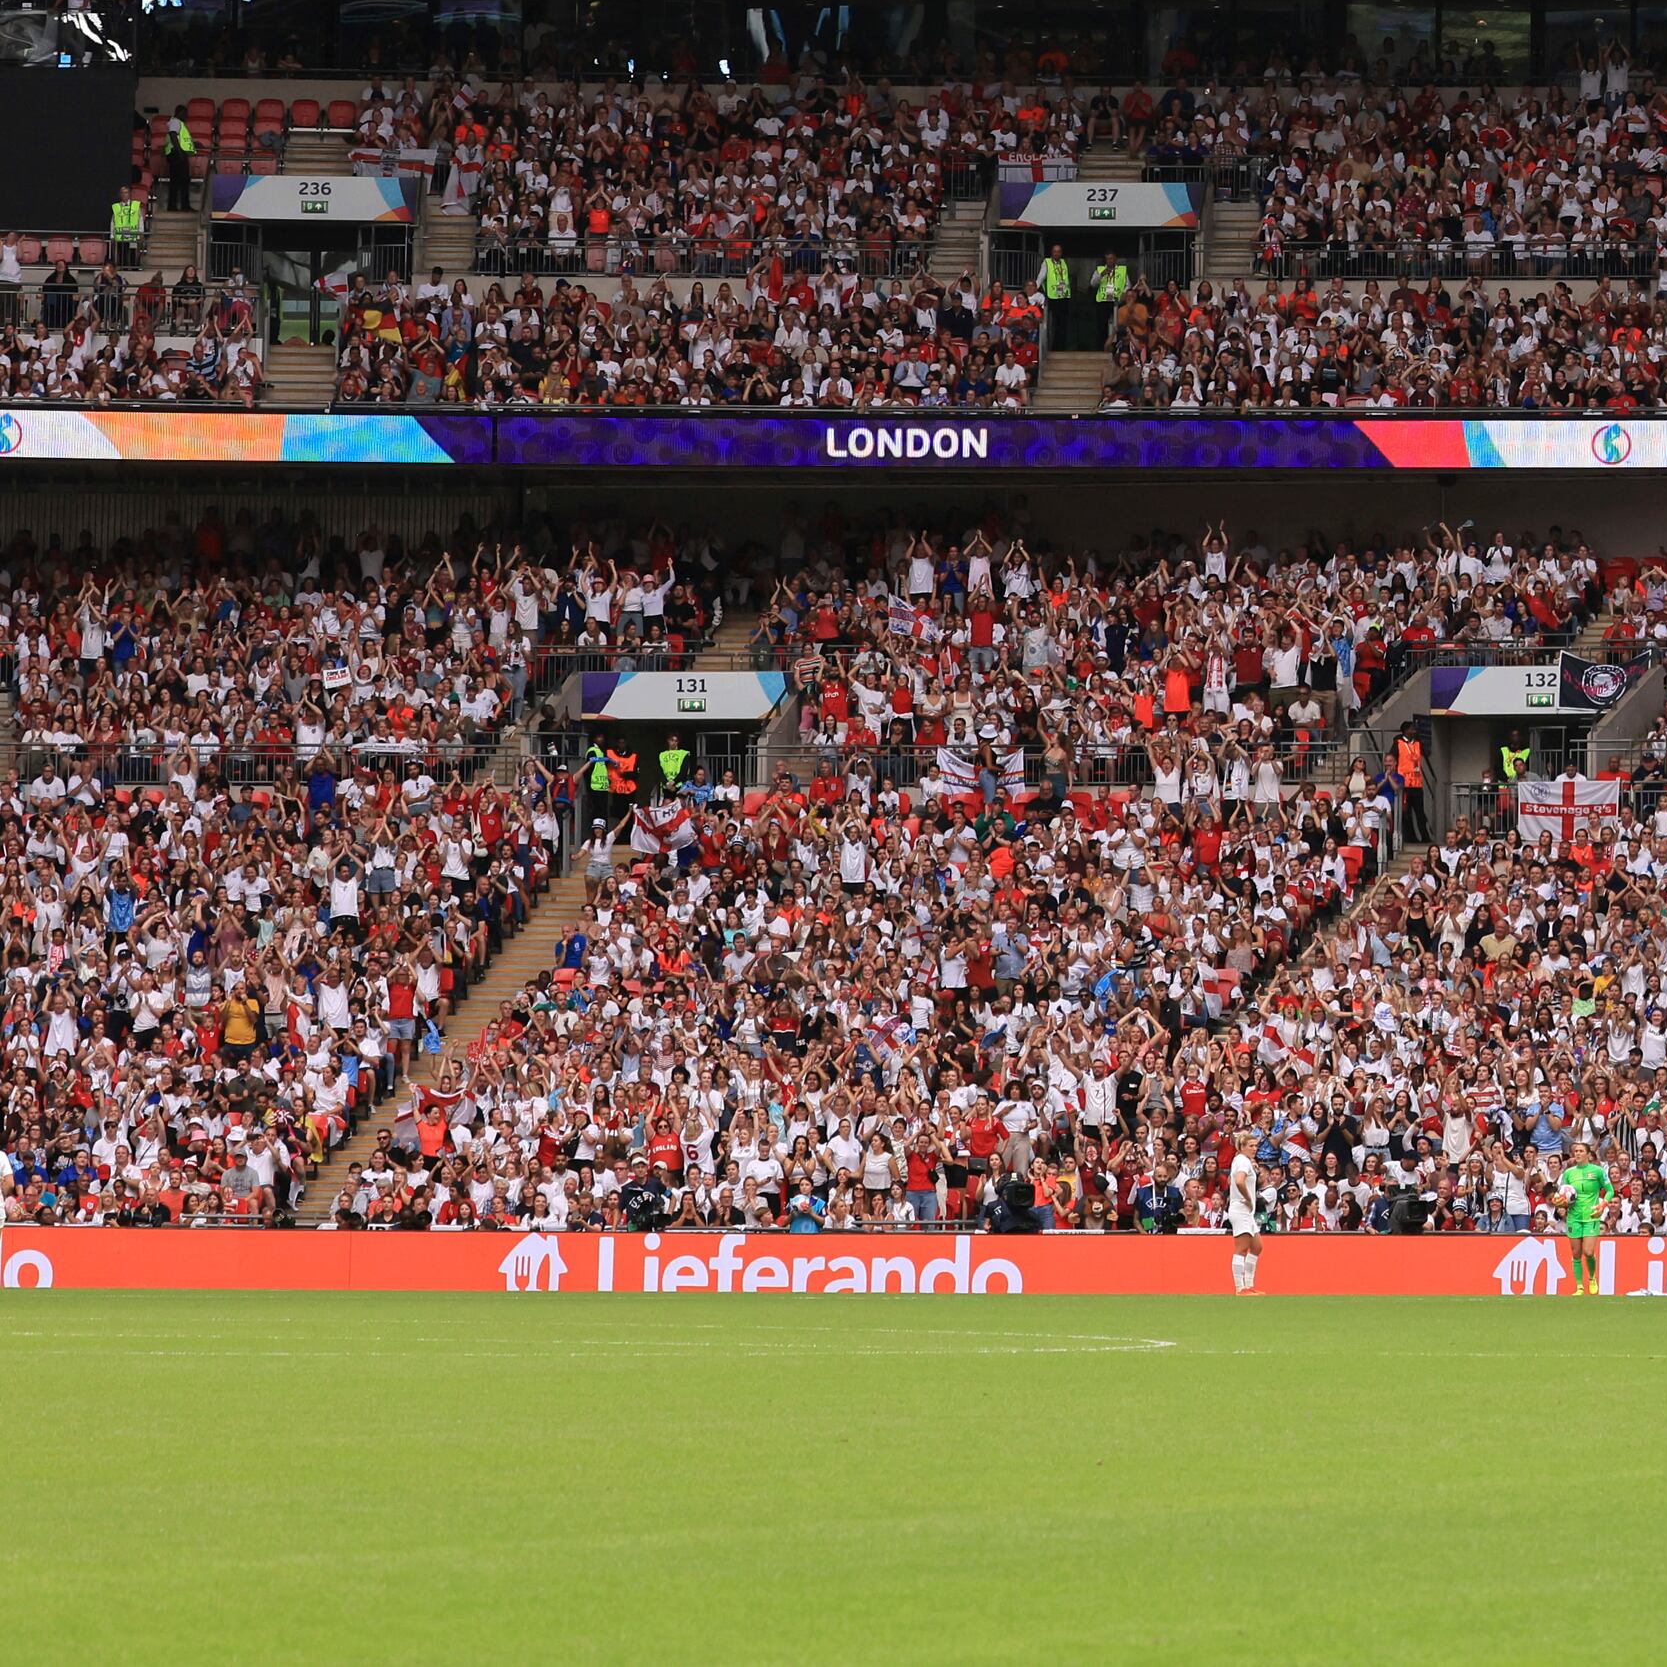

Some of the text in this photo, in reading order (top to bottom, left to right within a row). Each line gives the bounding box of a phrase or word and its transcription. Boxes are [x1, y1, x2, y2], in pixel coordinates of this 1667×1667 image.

[298, 182, 332, 196] 236
[1086, 189, 1119, 202] 237
[827, 428, 988, 458] LONDON
[676, 678, 708, 693] 131
[1525, 672, 1557, 687] 132
[1525, 804, 1583, 817] Stevenage
[686, 1144, 699, 1161] 6
[599, 1234, 1024, 1294] Lieferando
